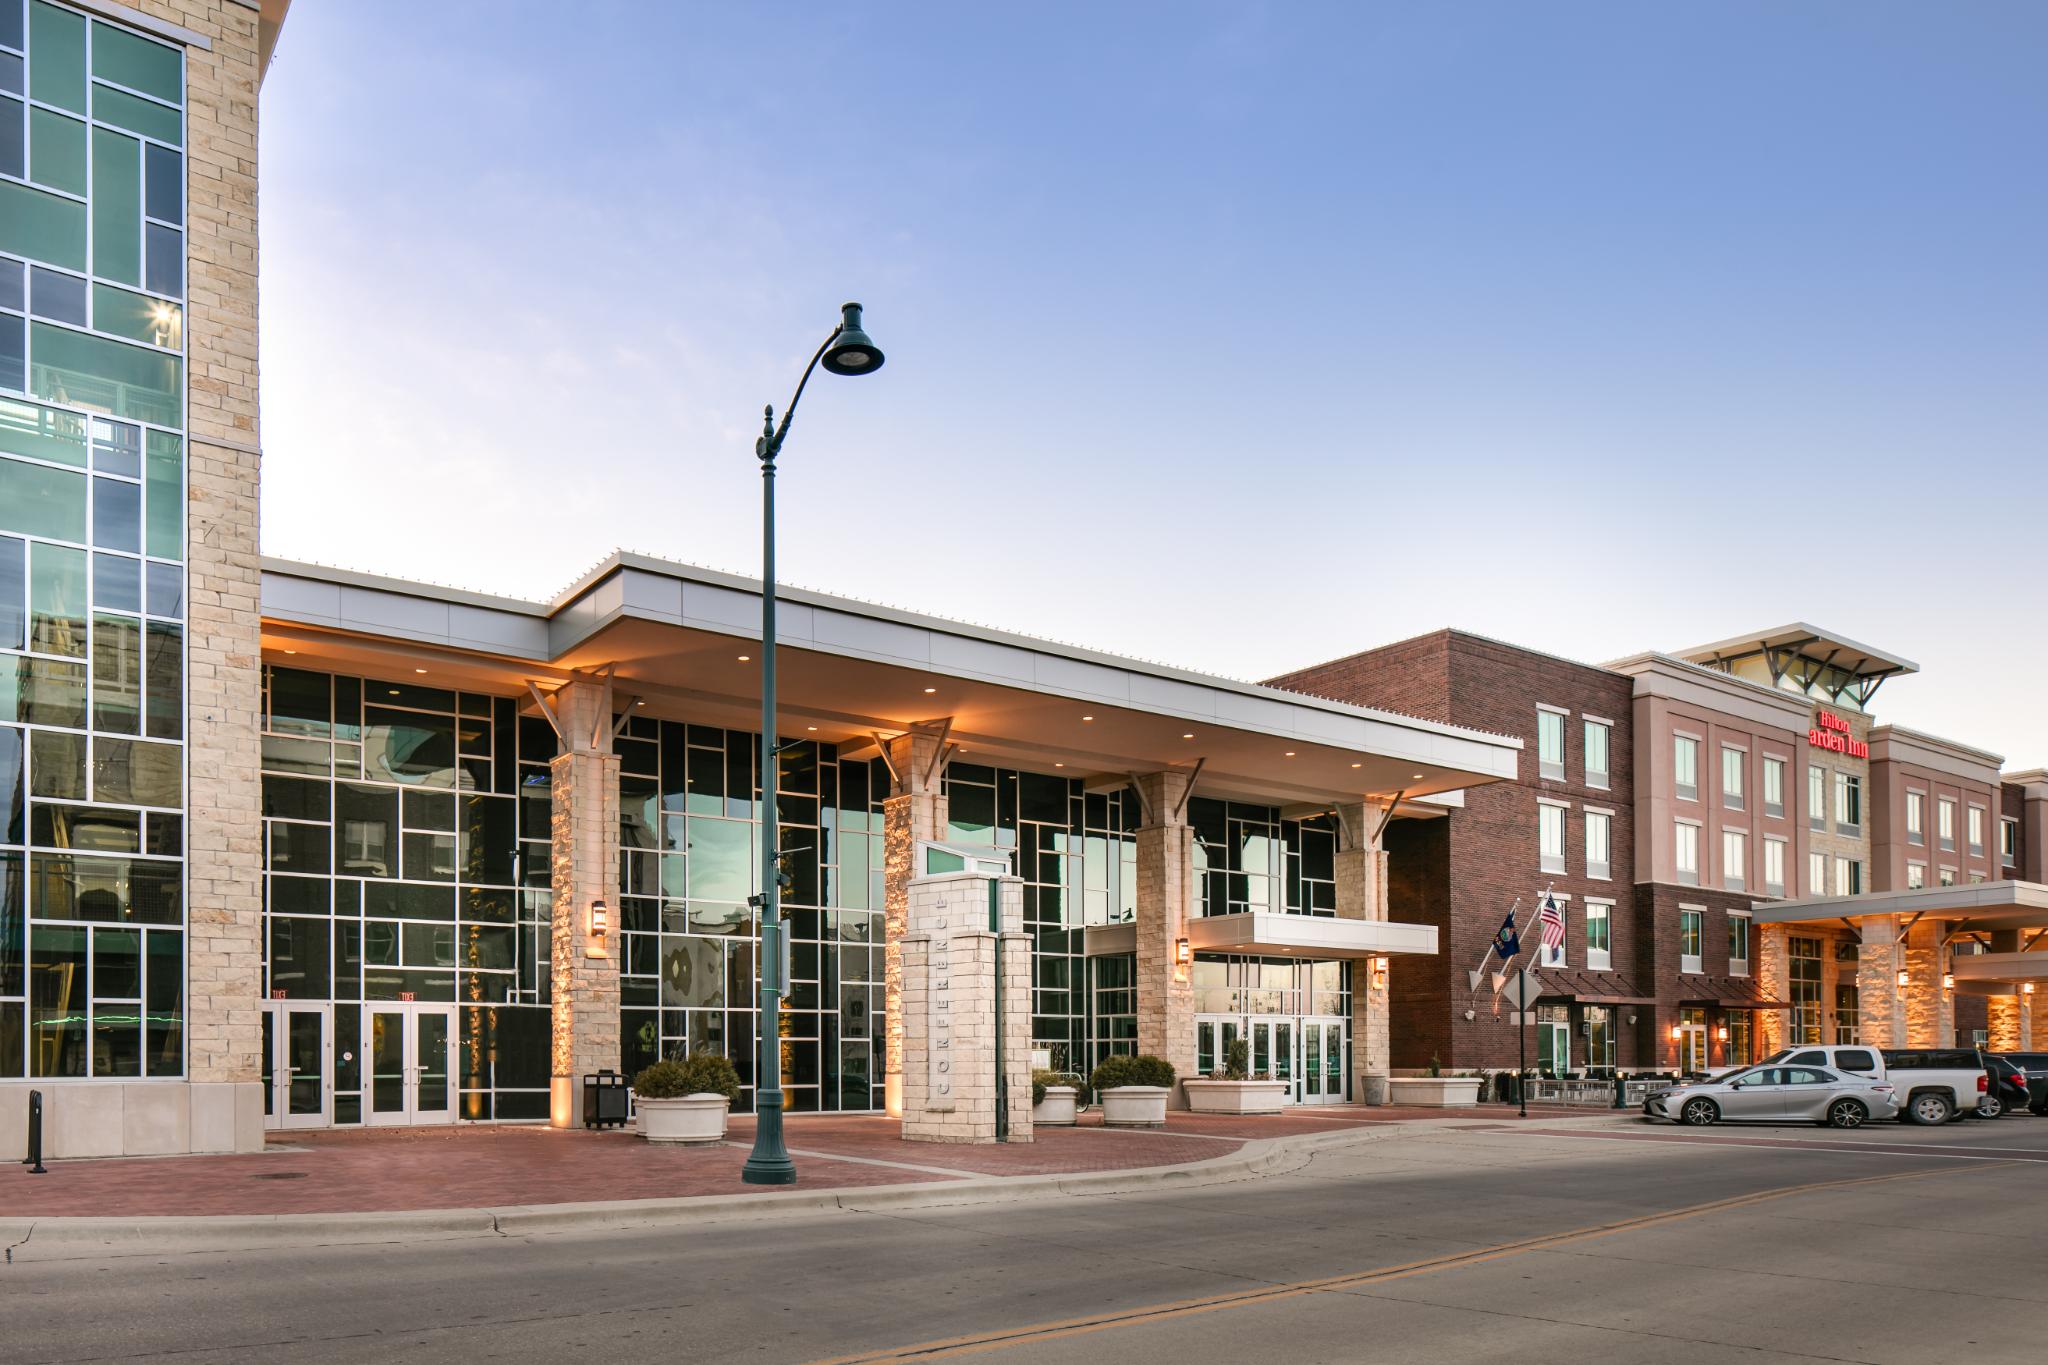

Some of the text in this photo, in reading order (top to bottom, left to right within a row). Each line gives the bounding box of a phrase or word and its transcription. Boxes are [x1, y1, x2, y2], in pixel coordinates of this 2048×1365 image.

[1820, 711, 1850, 733] Hilton
[1809, 729, 1869, 758] arden Inn
[936, 898, 949, 1095] CONFERENCE
